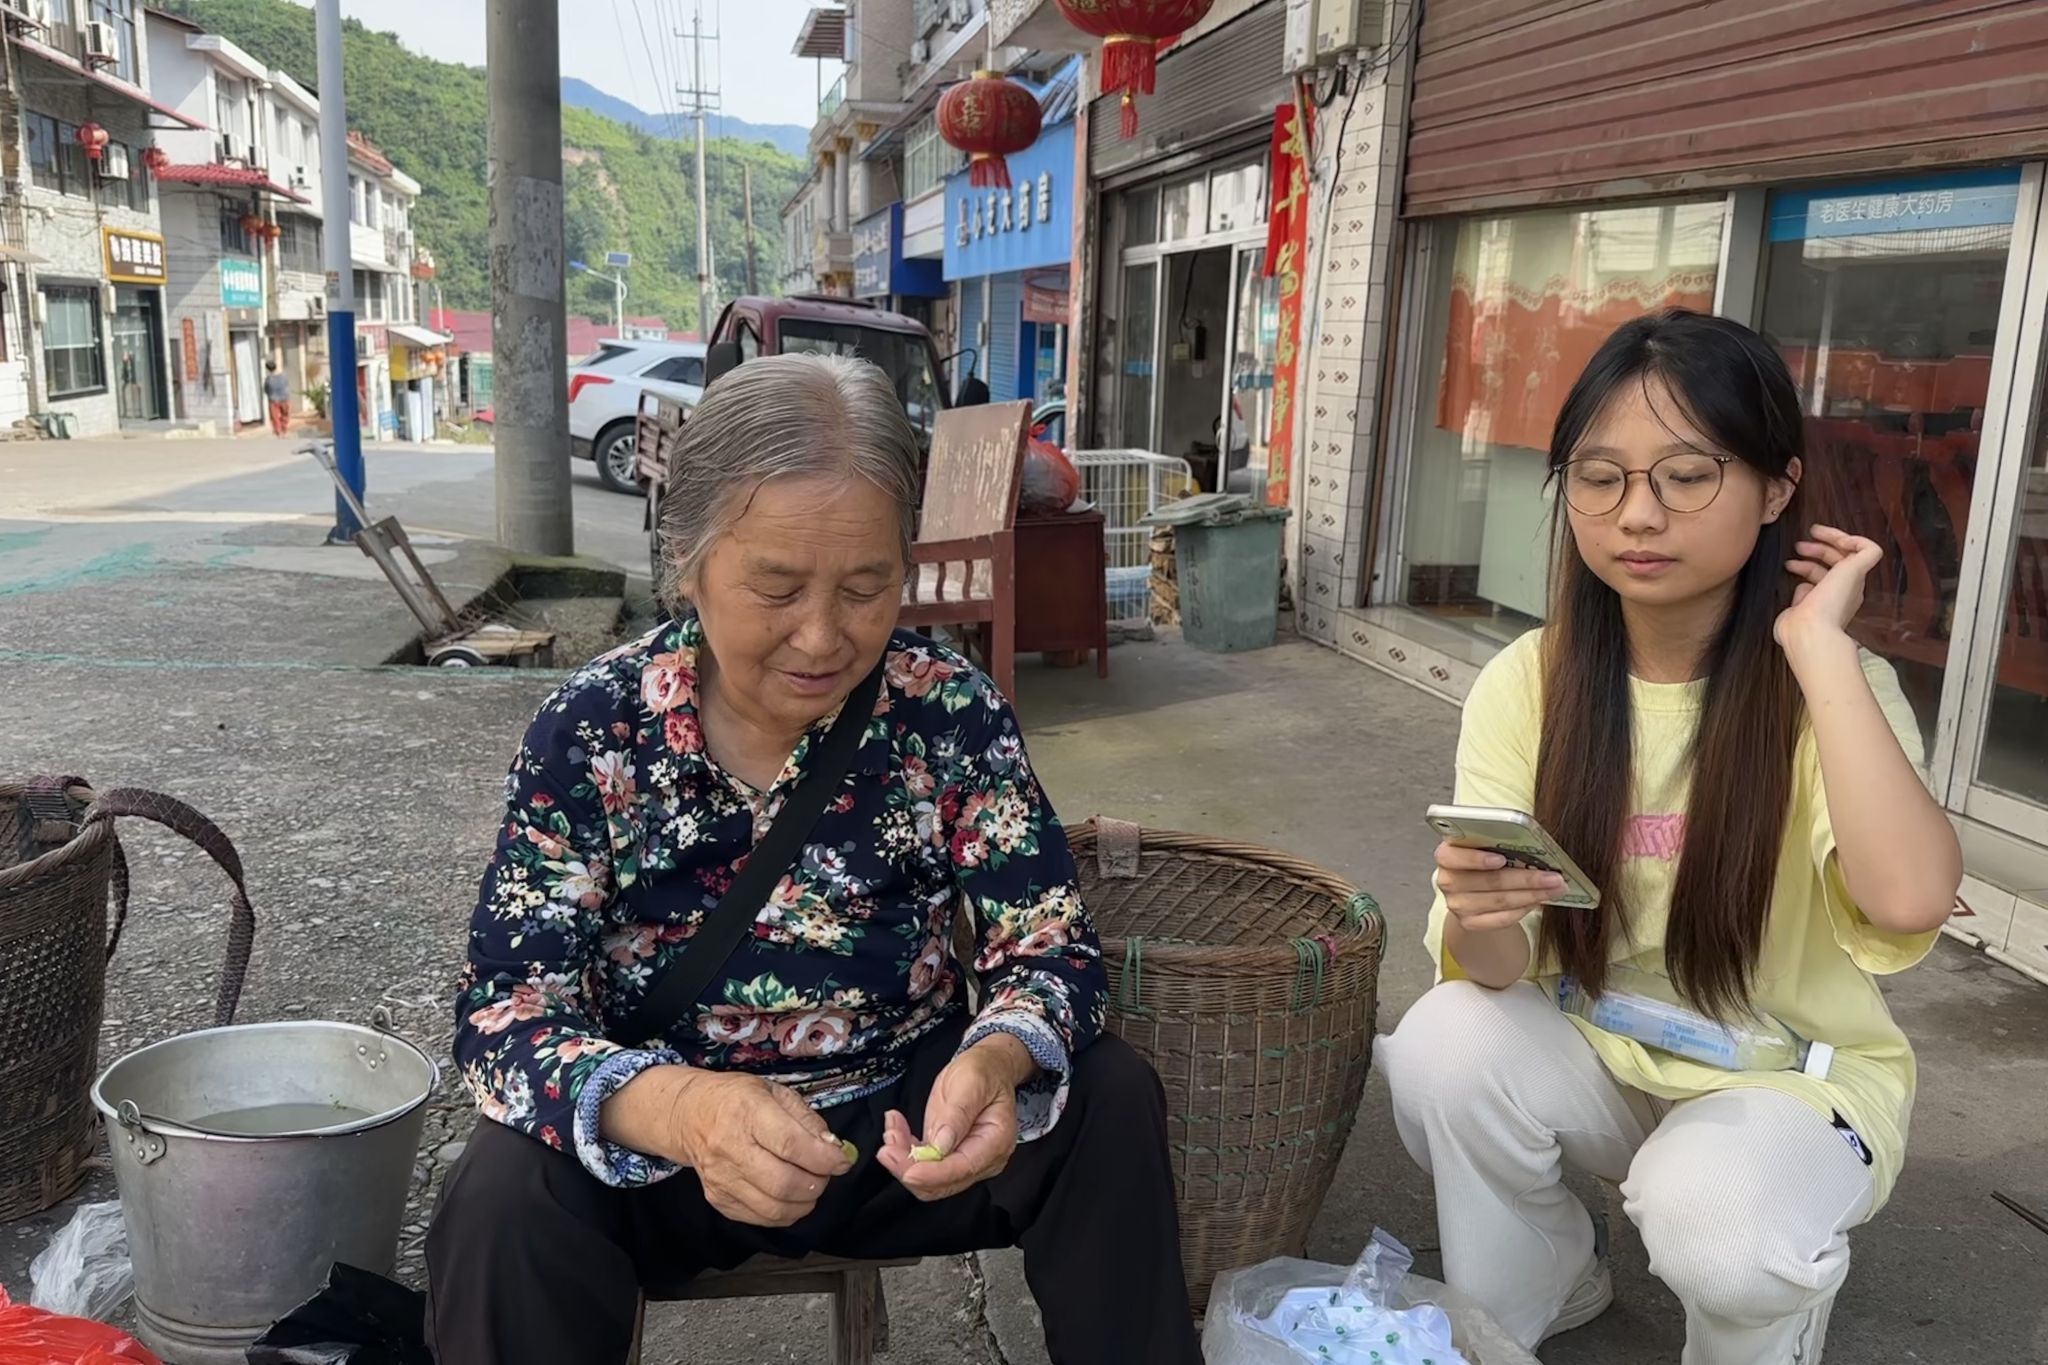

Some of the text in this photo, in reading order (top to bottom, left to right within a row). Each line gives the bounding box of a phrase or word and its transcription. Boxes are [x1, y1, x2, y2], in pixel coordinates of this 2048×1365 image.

[1820, 192, 1954, 223] 老医生健康大药房
